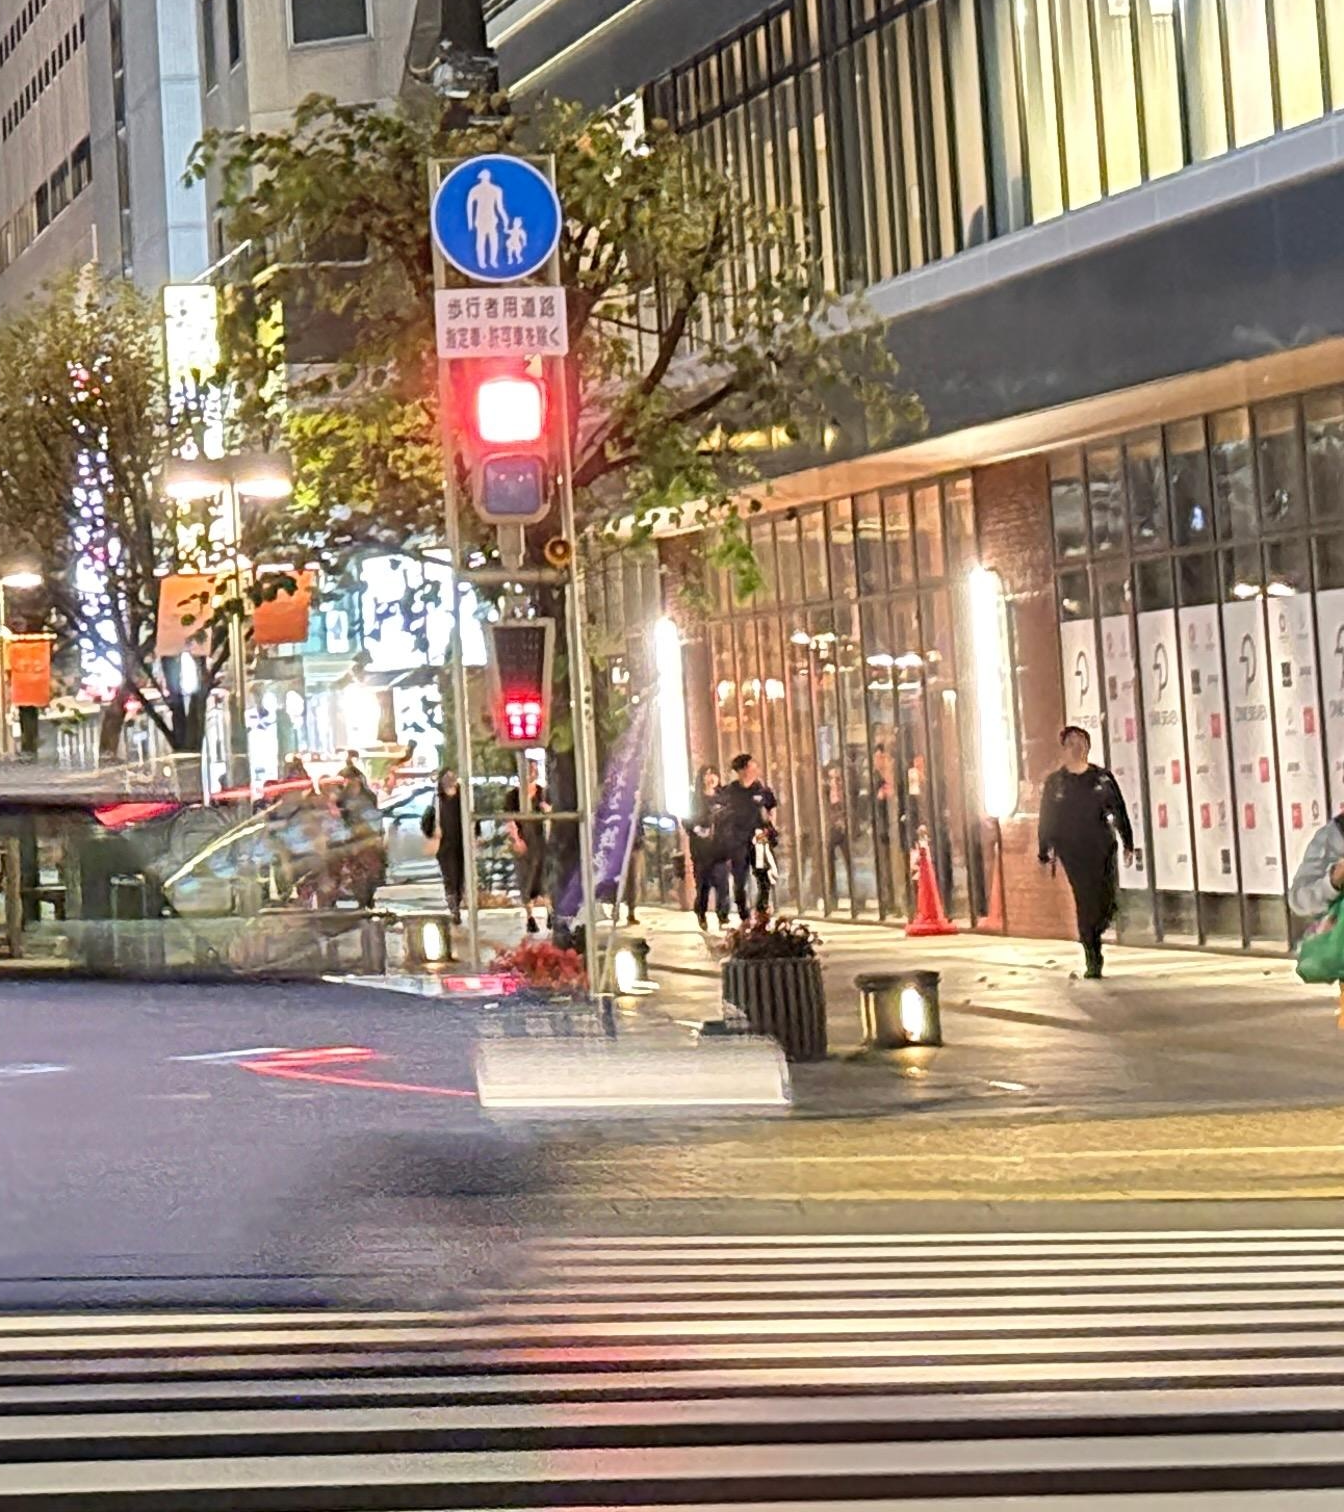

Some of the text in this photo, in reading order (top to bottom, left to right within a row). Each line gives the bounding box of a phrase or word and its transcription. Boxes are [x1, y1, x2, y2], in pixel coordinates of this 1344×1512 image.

[447, 295, 556, 321] 歩行者用道路
